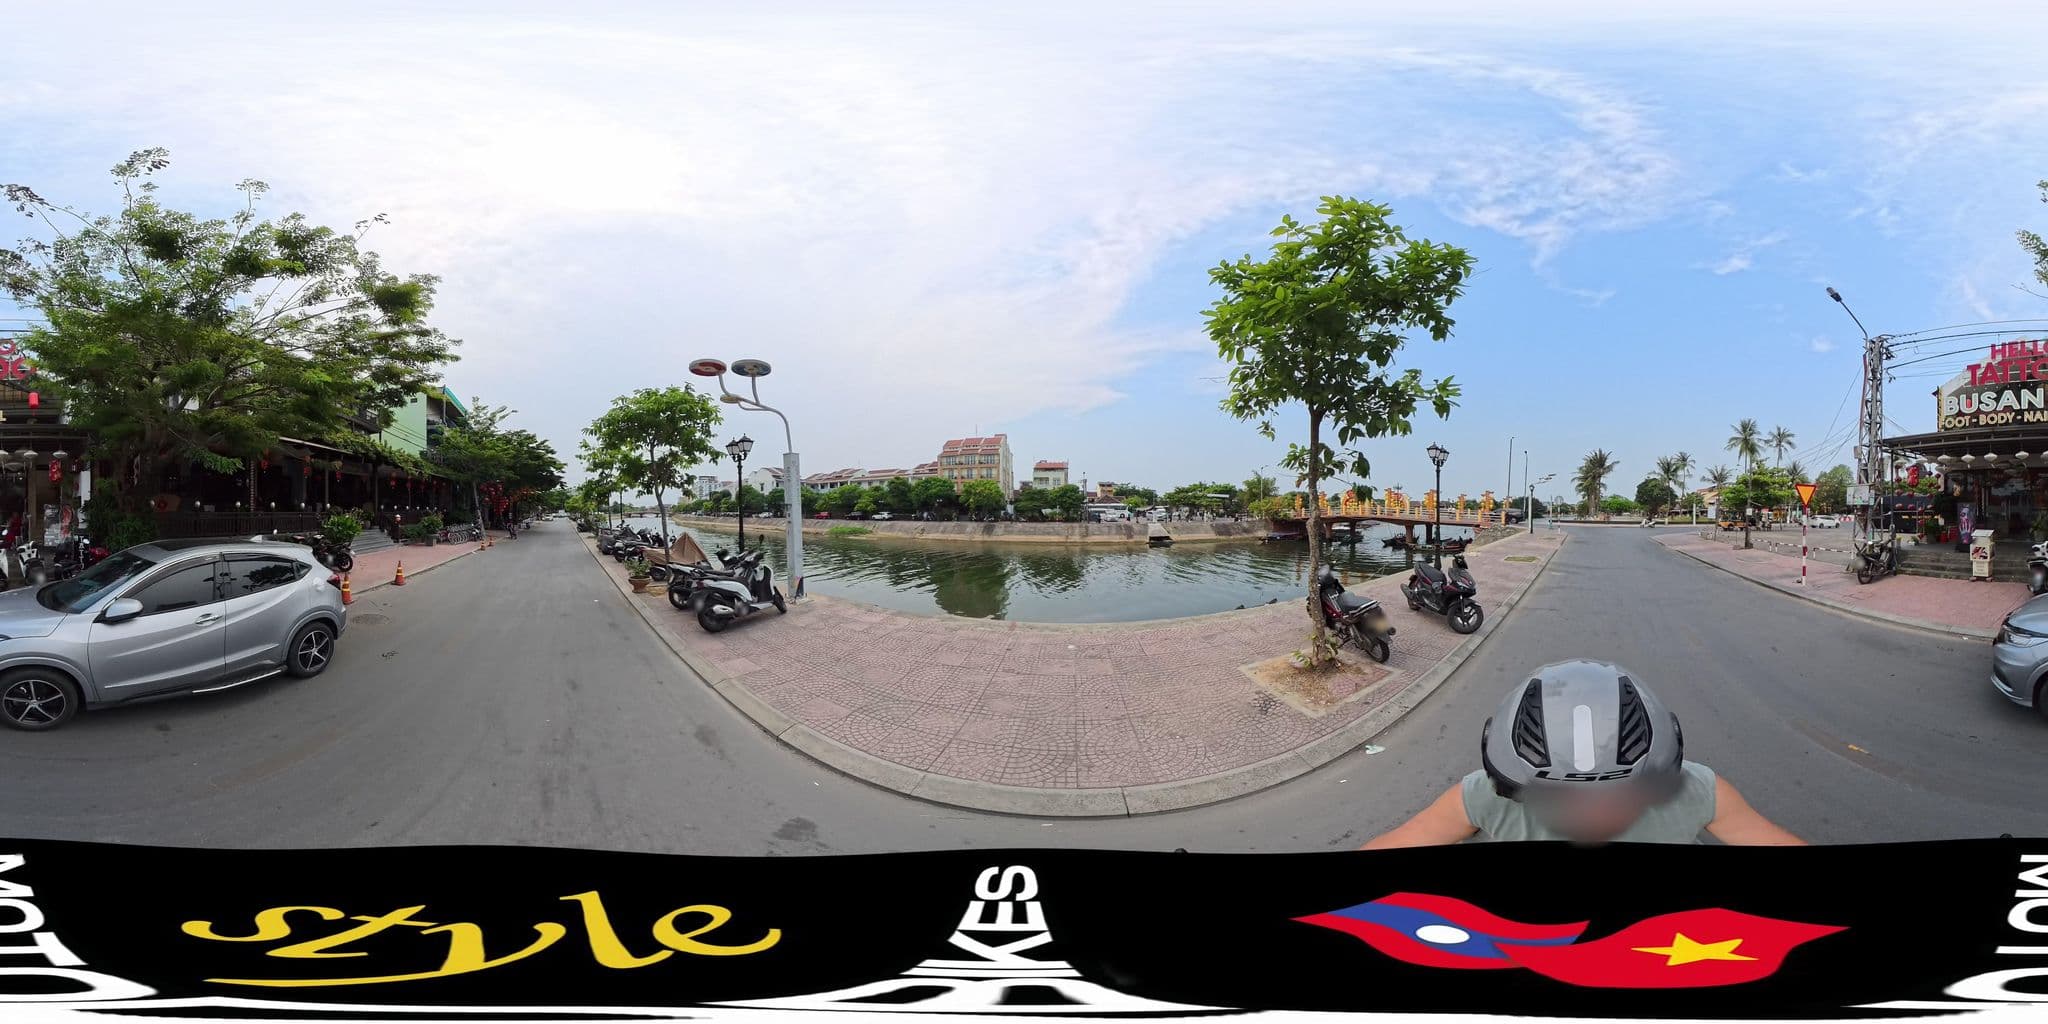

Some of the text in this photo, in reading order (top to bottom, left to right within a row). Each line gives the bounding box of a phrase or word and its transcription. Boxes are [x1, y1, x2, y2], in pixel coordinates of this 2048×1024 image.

[1944, 388, 2044, 416] BUSAN
[1979, 412, 2015, 426] BODY
[1535, 768, 1634, 782] LS2
